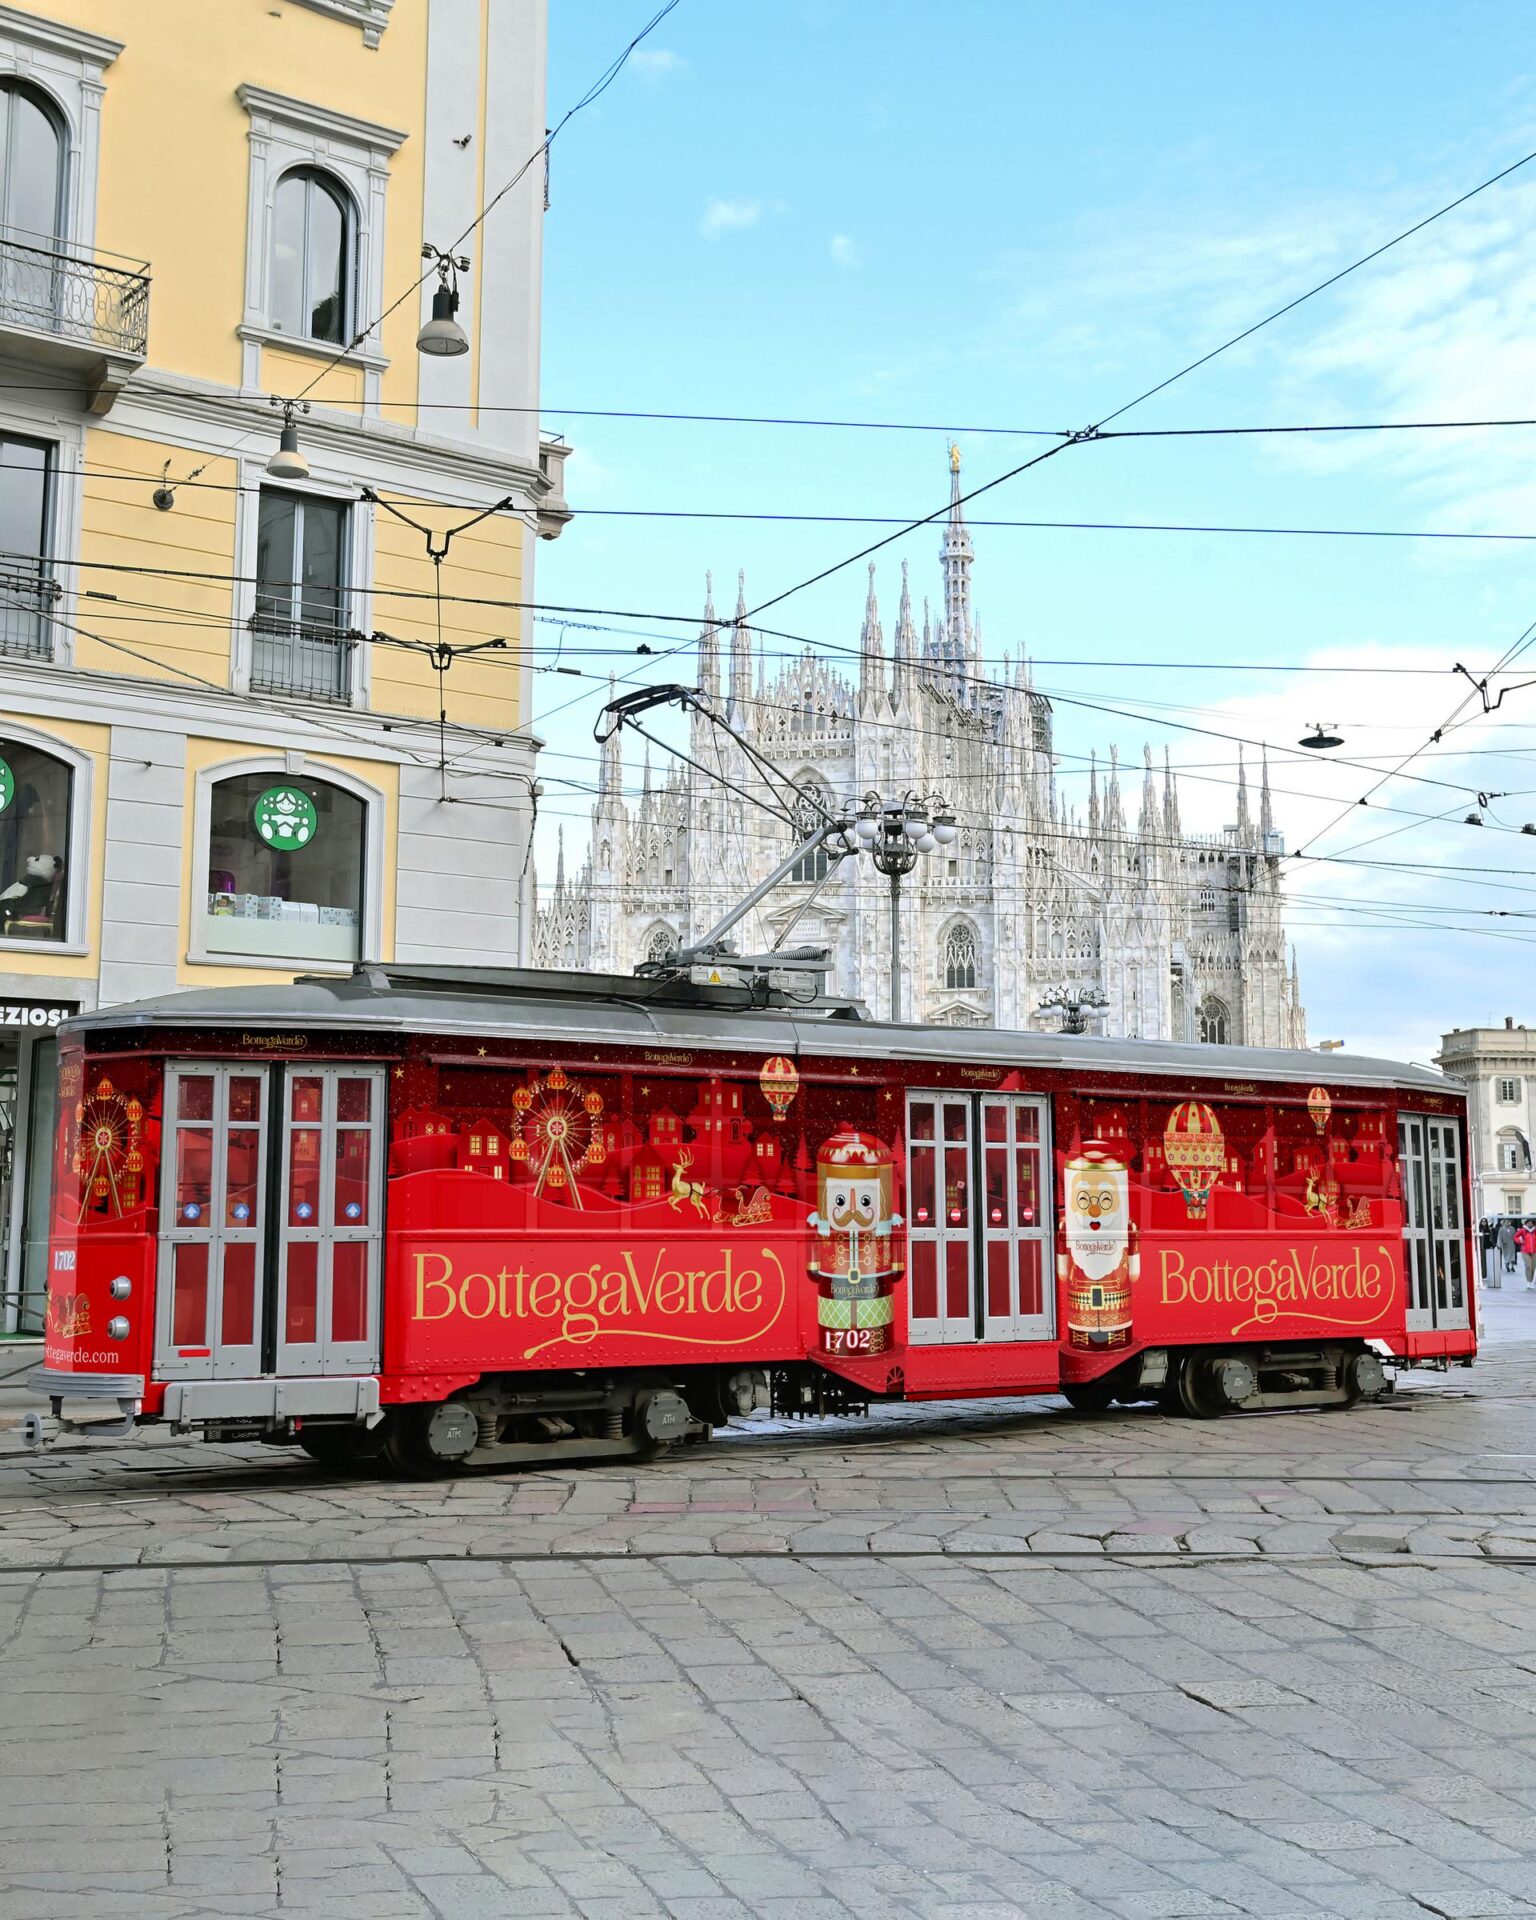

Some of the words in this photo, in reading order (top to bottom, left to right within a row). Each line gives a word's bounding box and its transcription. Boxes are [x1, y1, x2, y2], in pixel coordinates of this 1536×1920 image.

[54, 1250, 76, 1271] 1702
[1158, 1245, 1396, 1336] BottegaVerde
[411, 1247, 786, 1360] BottegaVerde
[825, 1329, 871, 1349] 1702
[446, 1427, 462, 1440] ATM
